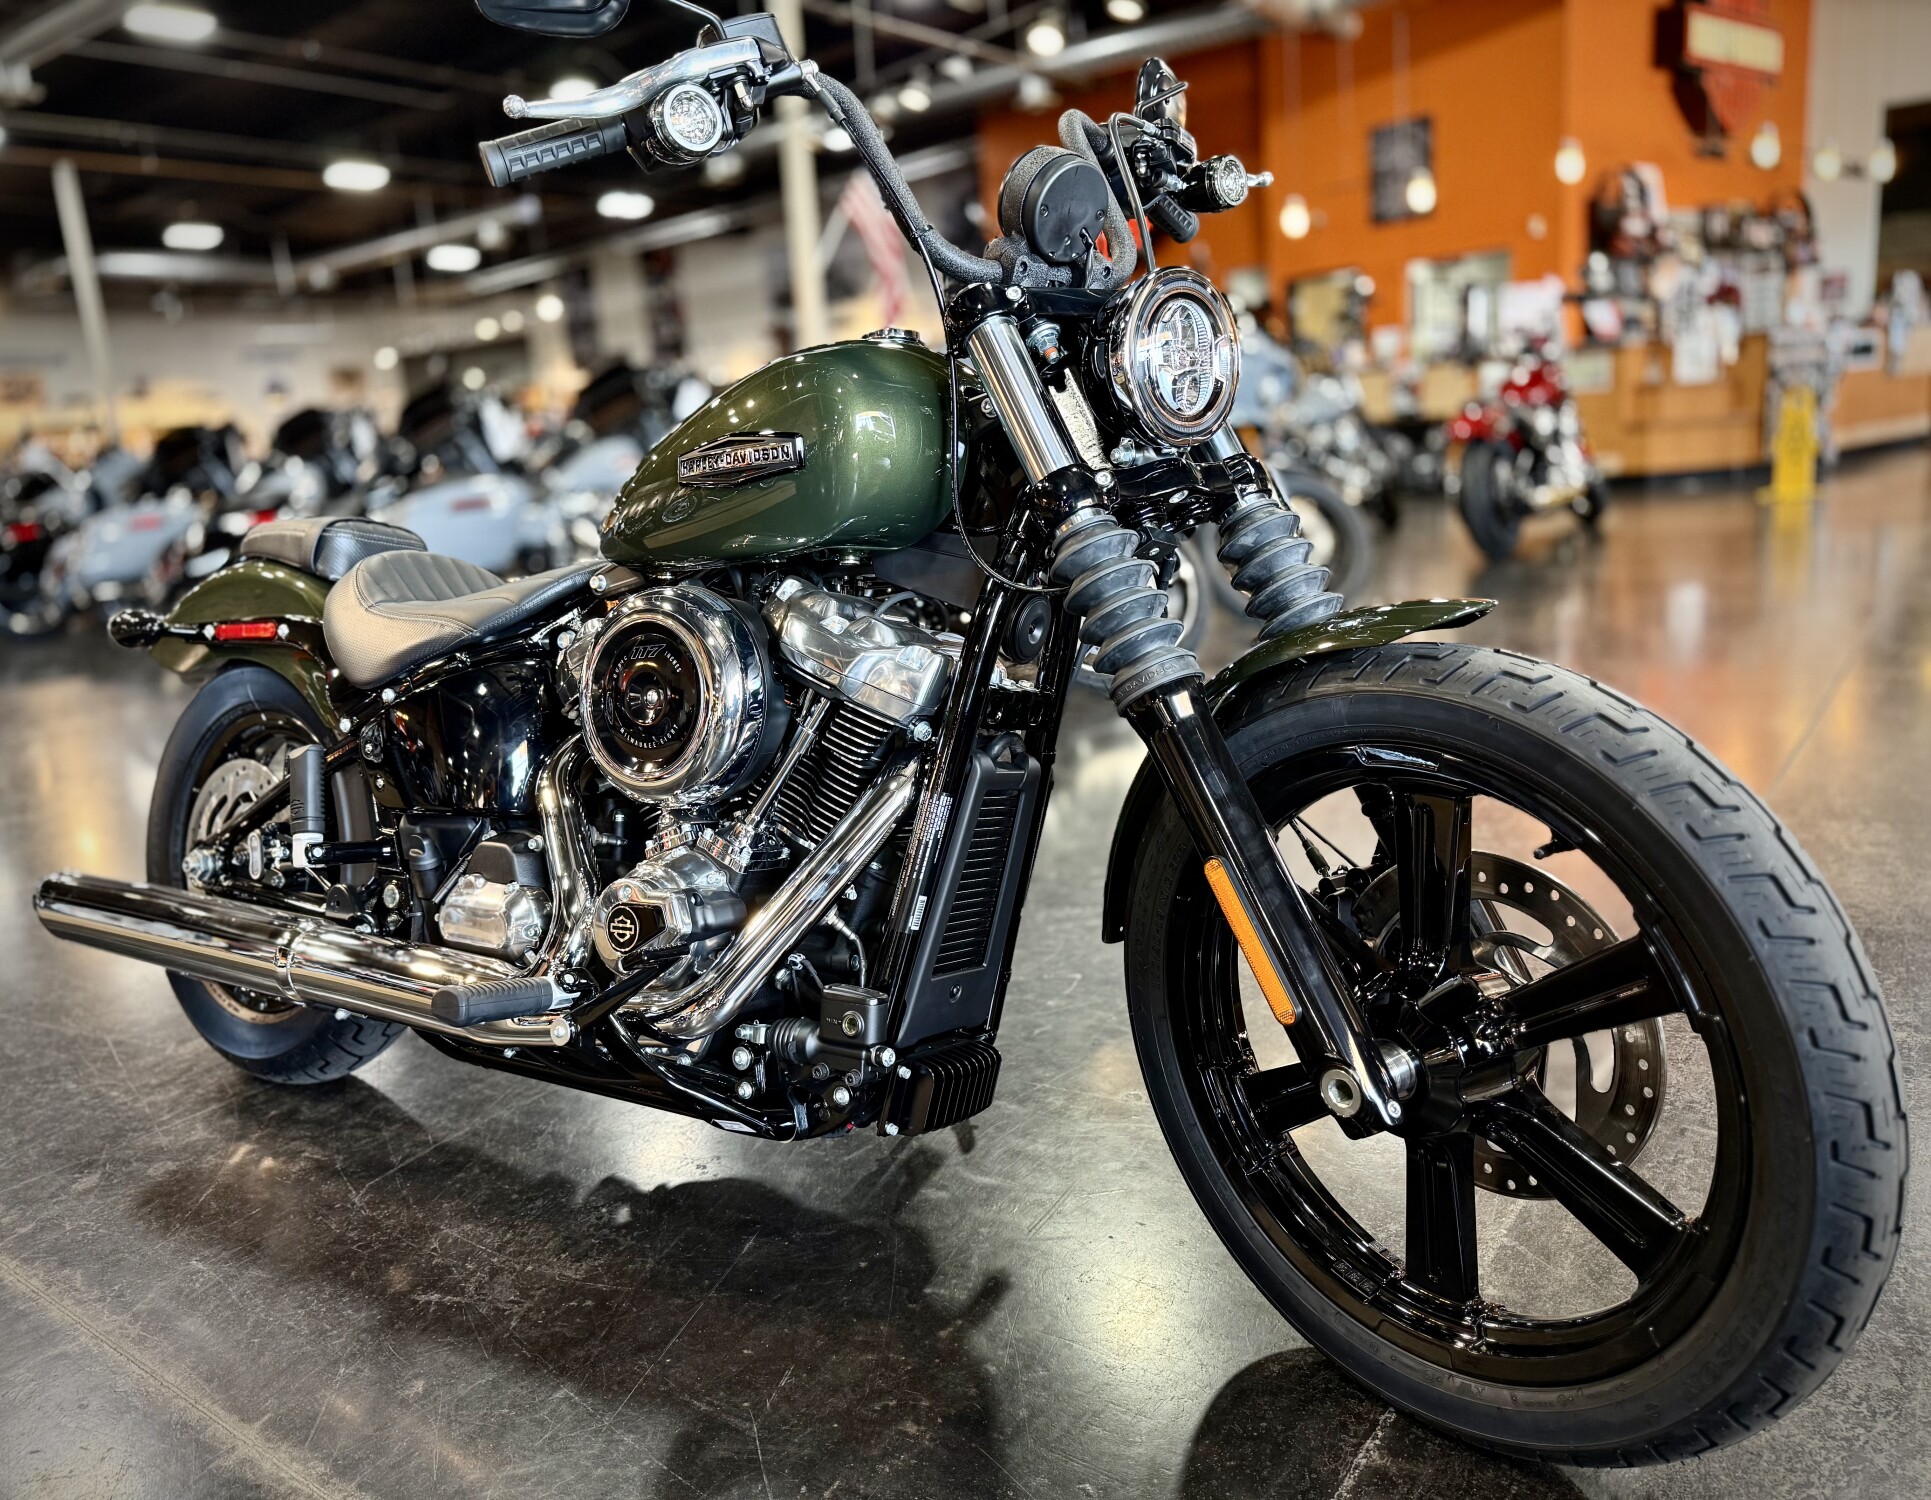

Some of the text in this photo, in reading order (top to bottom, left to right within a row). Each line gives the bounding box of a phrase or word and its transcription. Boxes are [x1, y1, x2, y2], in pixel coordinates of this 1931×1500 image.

[680, 443, 794, 477] HARLEY-DAVIDSON
[630, 643, 667, 660] 117
[664, 650, 682, 673] INCHES
